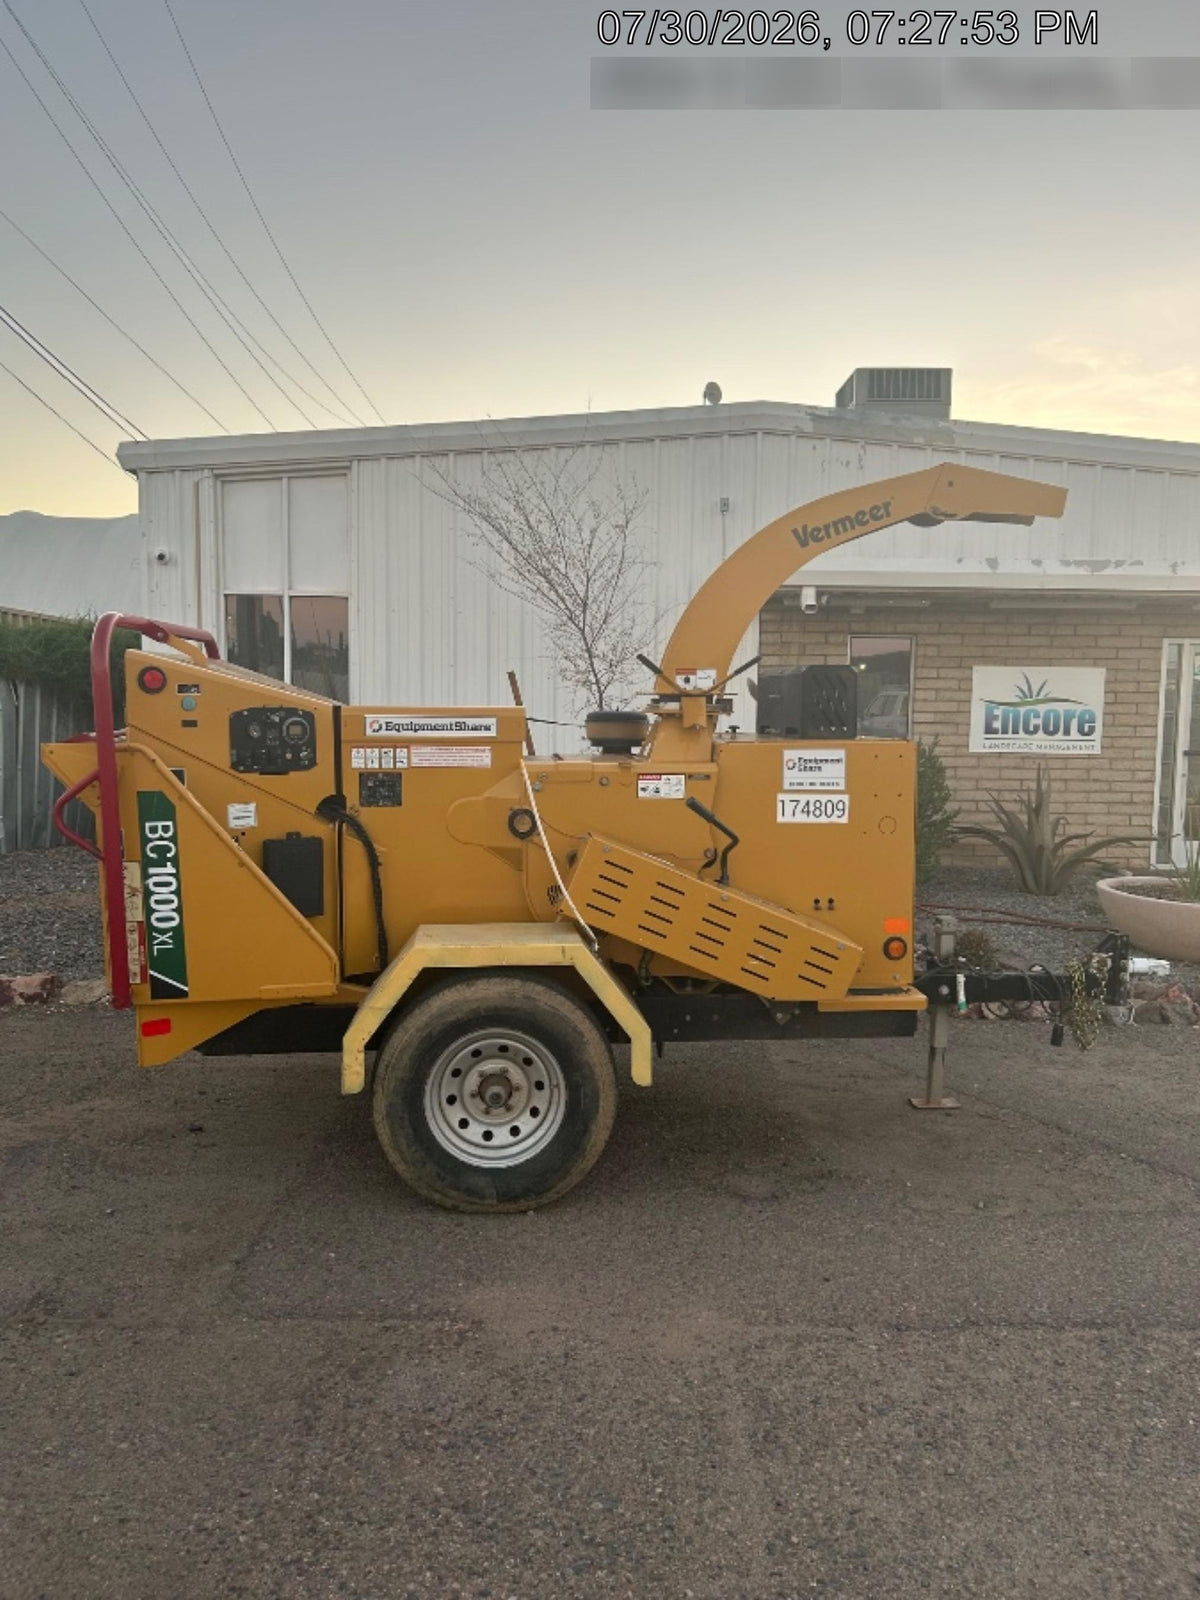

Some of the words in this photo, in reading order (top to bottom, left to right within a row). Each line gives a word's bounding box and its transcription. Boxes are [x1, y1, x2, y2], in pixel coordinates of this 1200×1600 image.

[791, 500, 892, 549] Vermeer
[984, 703, 1097, 737] Encore
[779, 799, 846, 819] 174809
